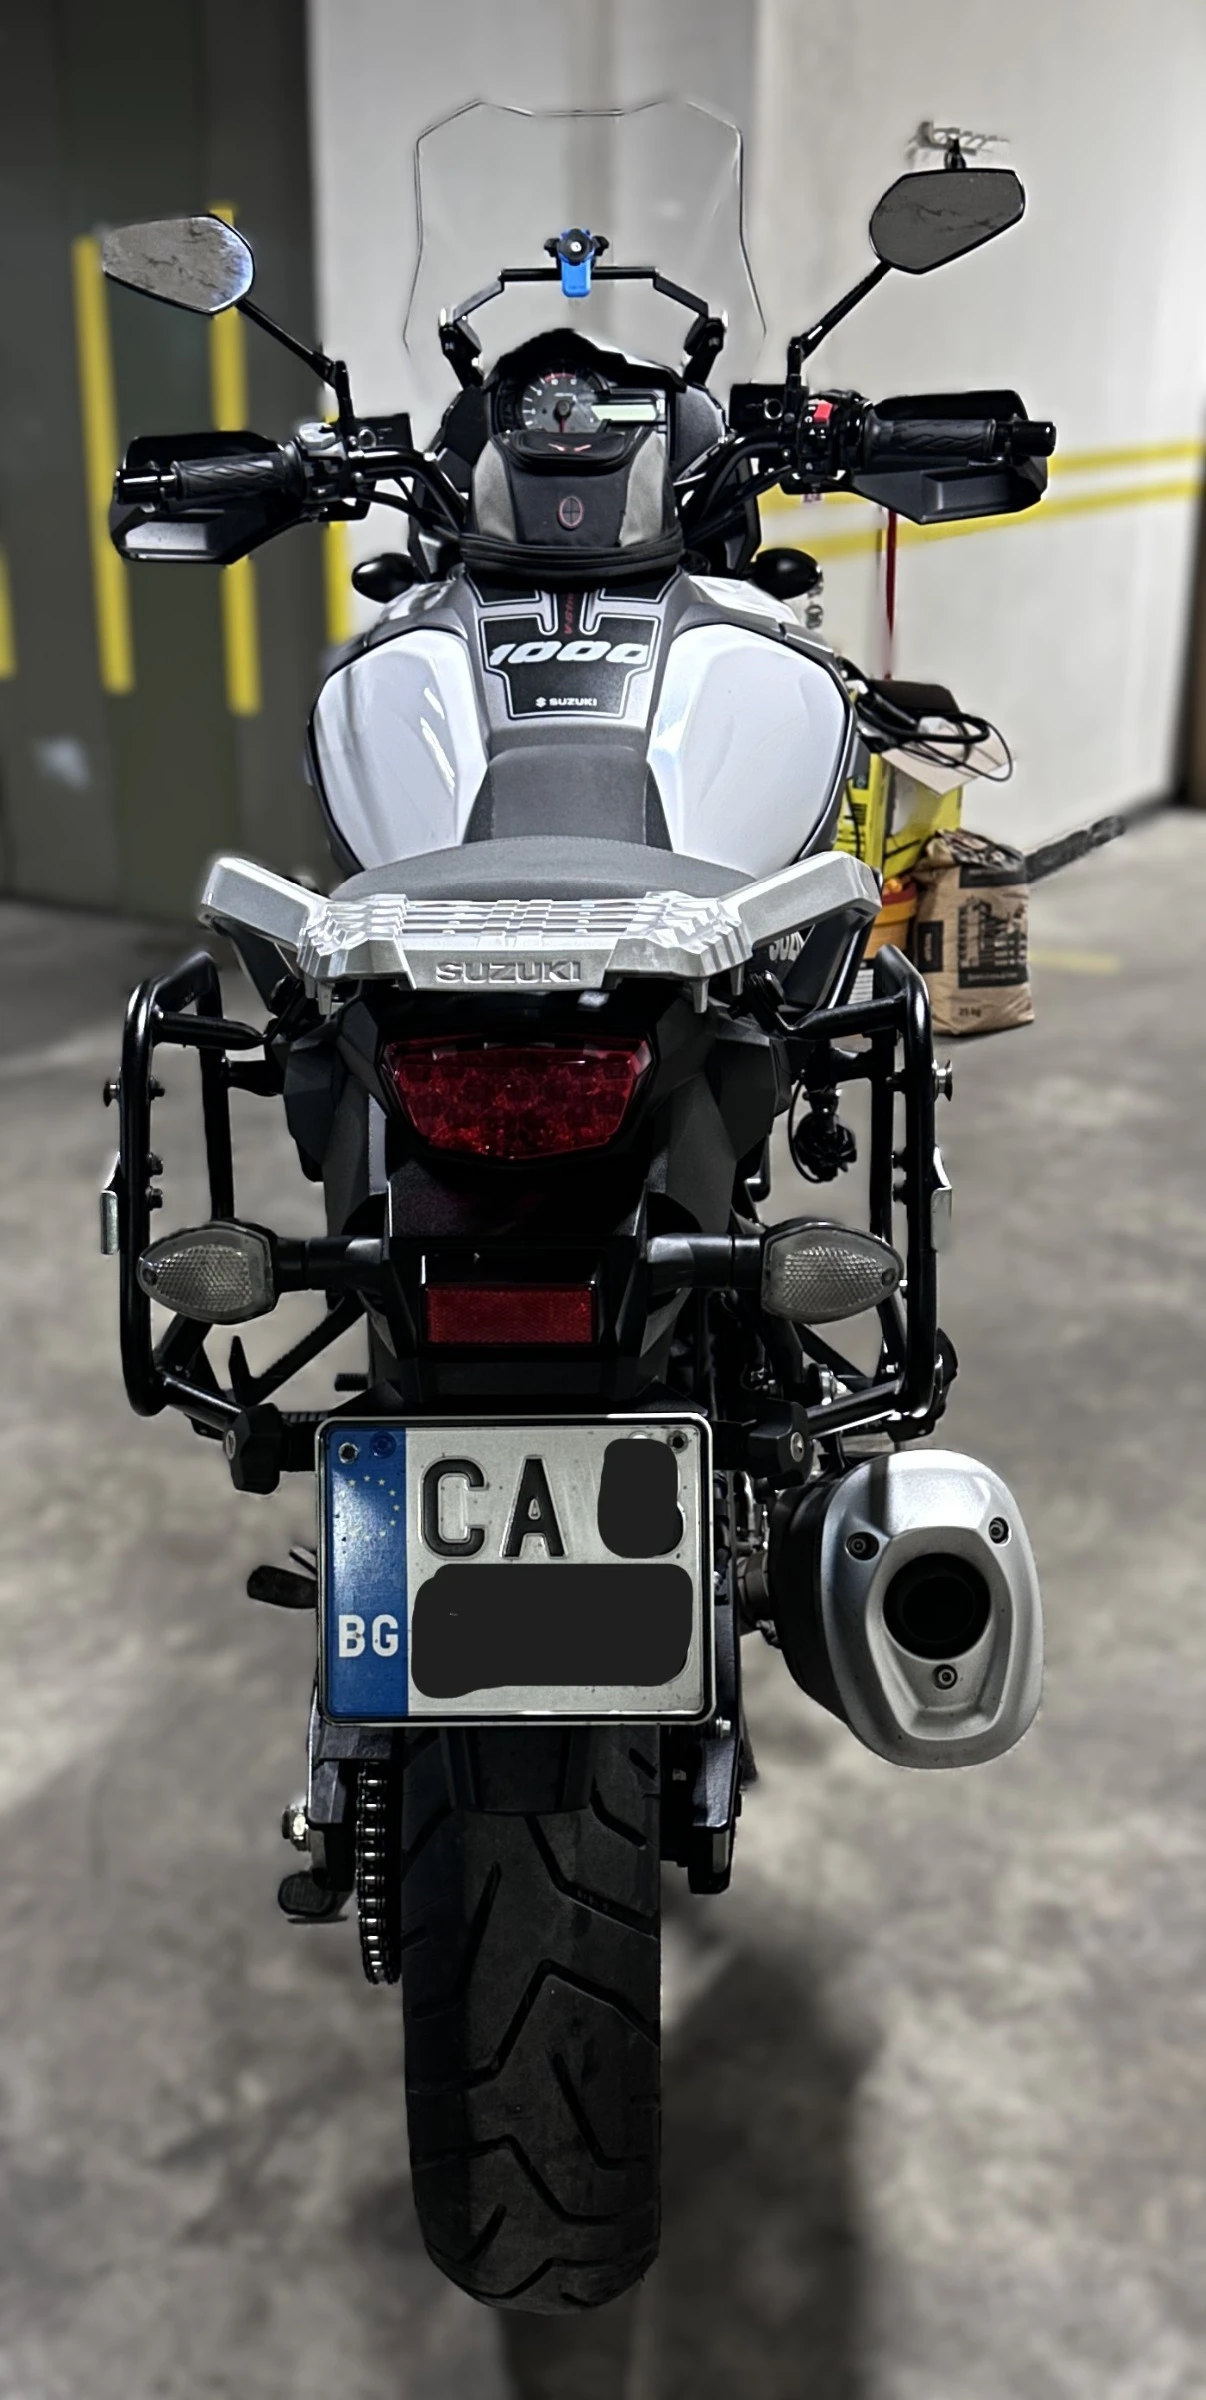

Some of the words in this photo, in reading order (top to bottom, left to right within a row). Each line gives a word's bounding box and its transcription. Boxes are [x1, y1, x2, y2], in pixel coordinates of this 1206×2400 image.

[489, 640, 649, 666] 1000
[549, 697, 598, 707] SUZUKI
[435, 960, 583, 985] SUZUKI
[420, 1455, 567, 1560] CA
[338, 1614, 399, 1658] BG
